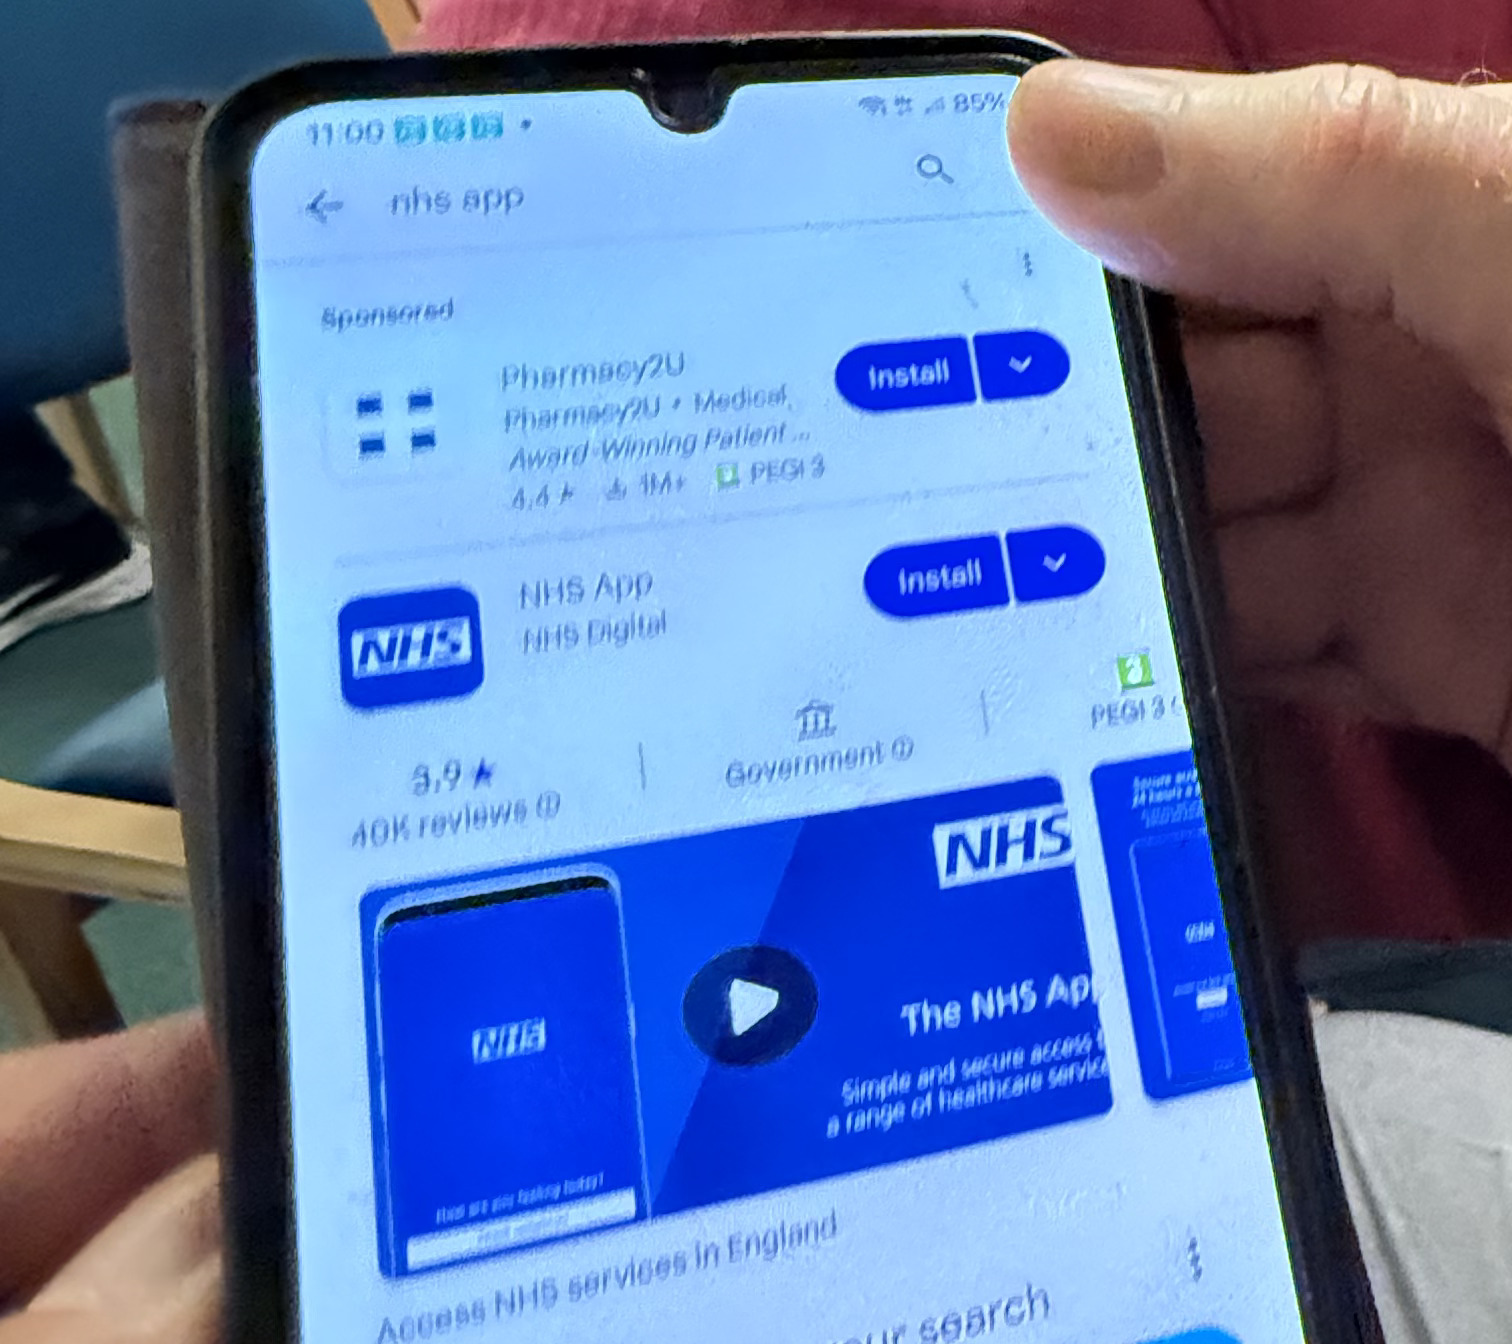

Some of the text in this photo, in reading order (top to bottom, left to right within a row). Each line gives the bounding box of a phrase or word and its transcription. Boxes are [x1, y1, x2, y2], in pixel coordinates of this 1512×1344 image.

[953, 91, 1006, 114] 85%
[306, 117, 384, 146] 11:00
[391, 185, 525, 216] nhs app
[321, 297, 455, 332] Sponsored
[501, 352, 686, 393] Pharmacy2U
[867, 357, 950, 391] Install
[504, 395, 661, 434] Pharmacy2U
[703, 420, 787, 451] Patient
[511, 484, 550, 512] 4.4
[751, 456, 804, 485] PEGI
[519, 571, 654, 610] NHS App
[898, 558, 982, 597] Install
[356, 625, 466, 669] NHS
[523, 608, 667, 656] NHS Digital
[1091, 694, 1166, 729] PEGI 3
[725, 739, 884, 789] Government
[351, 798, 528, 849] 40K reviews
[945, 809, 1072, 878] NHS
[900, 998, 962, 1037] The
[970, 978, 1038, 1024] NHS
[841, 1069, 912, 1108] Simple
[917, 1057, 956, 1091] and
[961, 1046, 1026, 1081] secure
[1030, 1032, 1093, 1067] access
[826, 1114, 840, 1140] a
[845, 1099, 906, 1133] range
[911, 1091, 933, 1121] of
[939, 1070, 1044, 1114] healthcare
[494, 1277, 558, 1320] NHS
[568, 1249, 687, 1304] services
[696, 1239, 720, 1270] in
[727, 1206, 838, 1263] England
